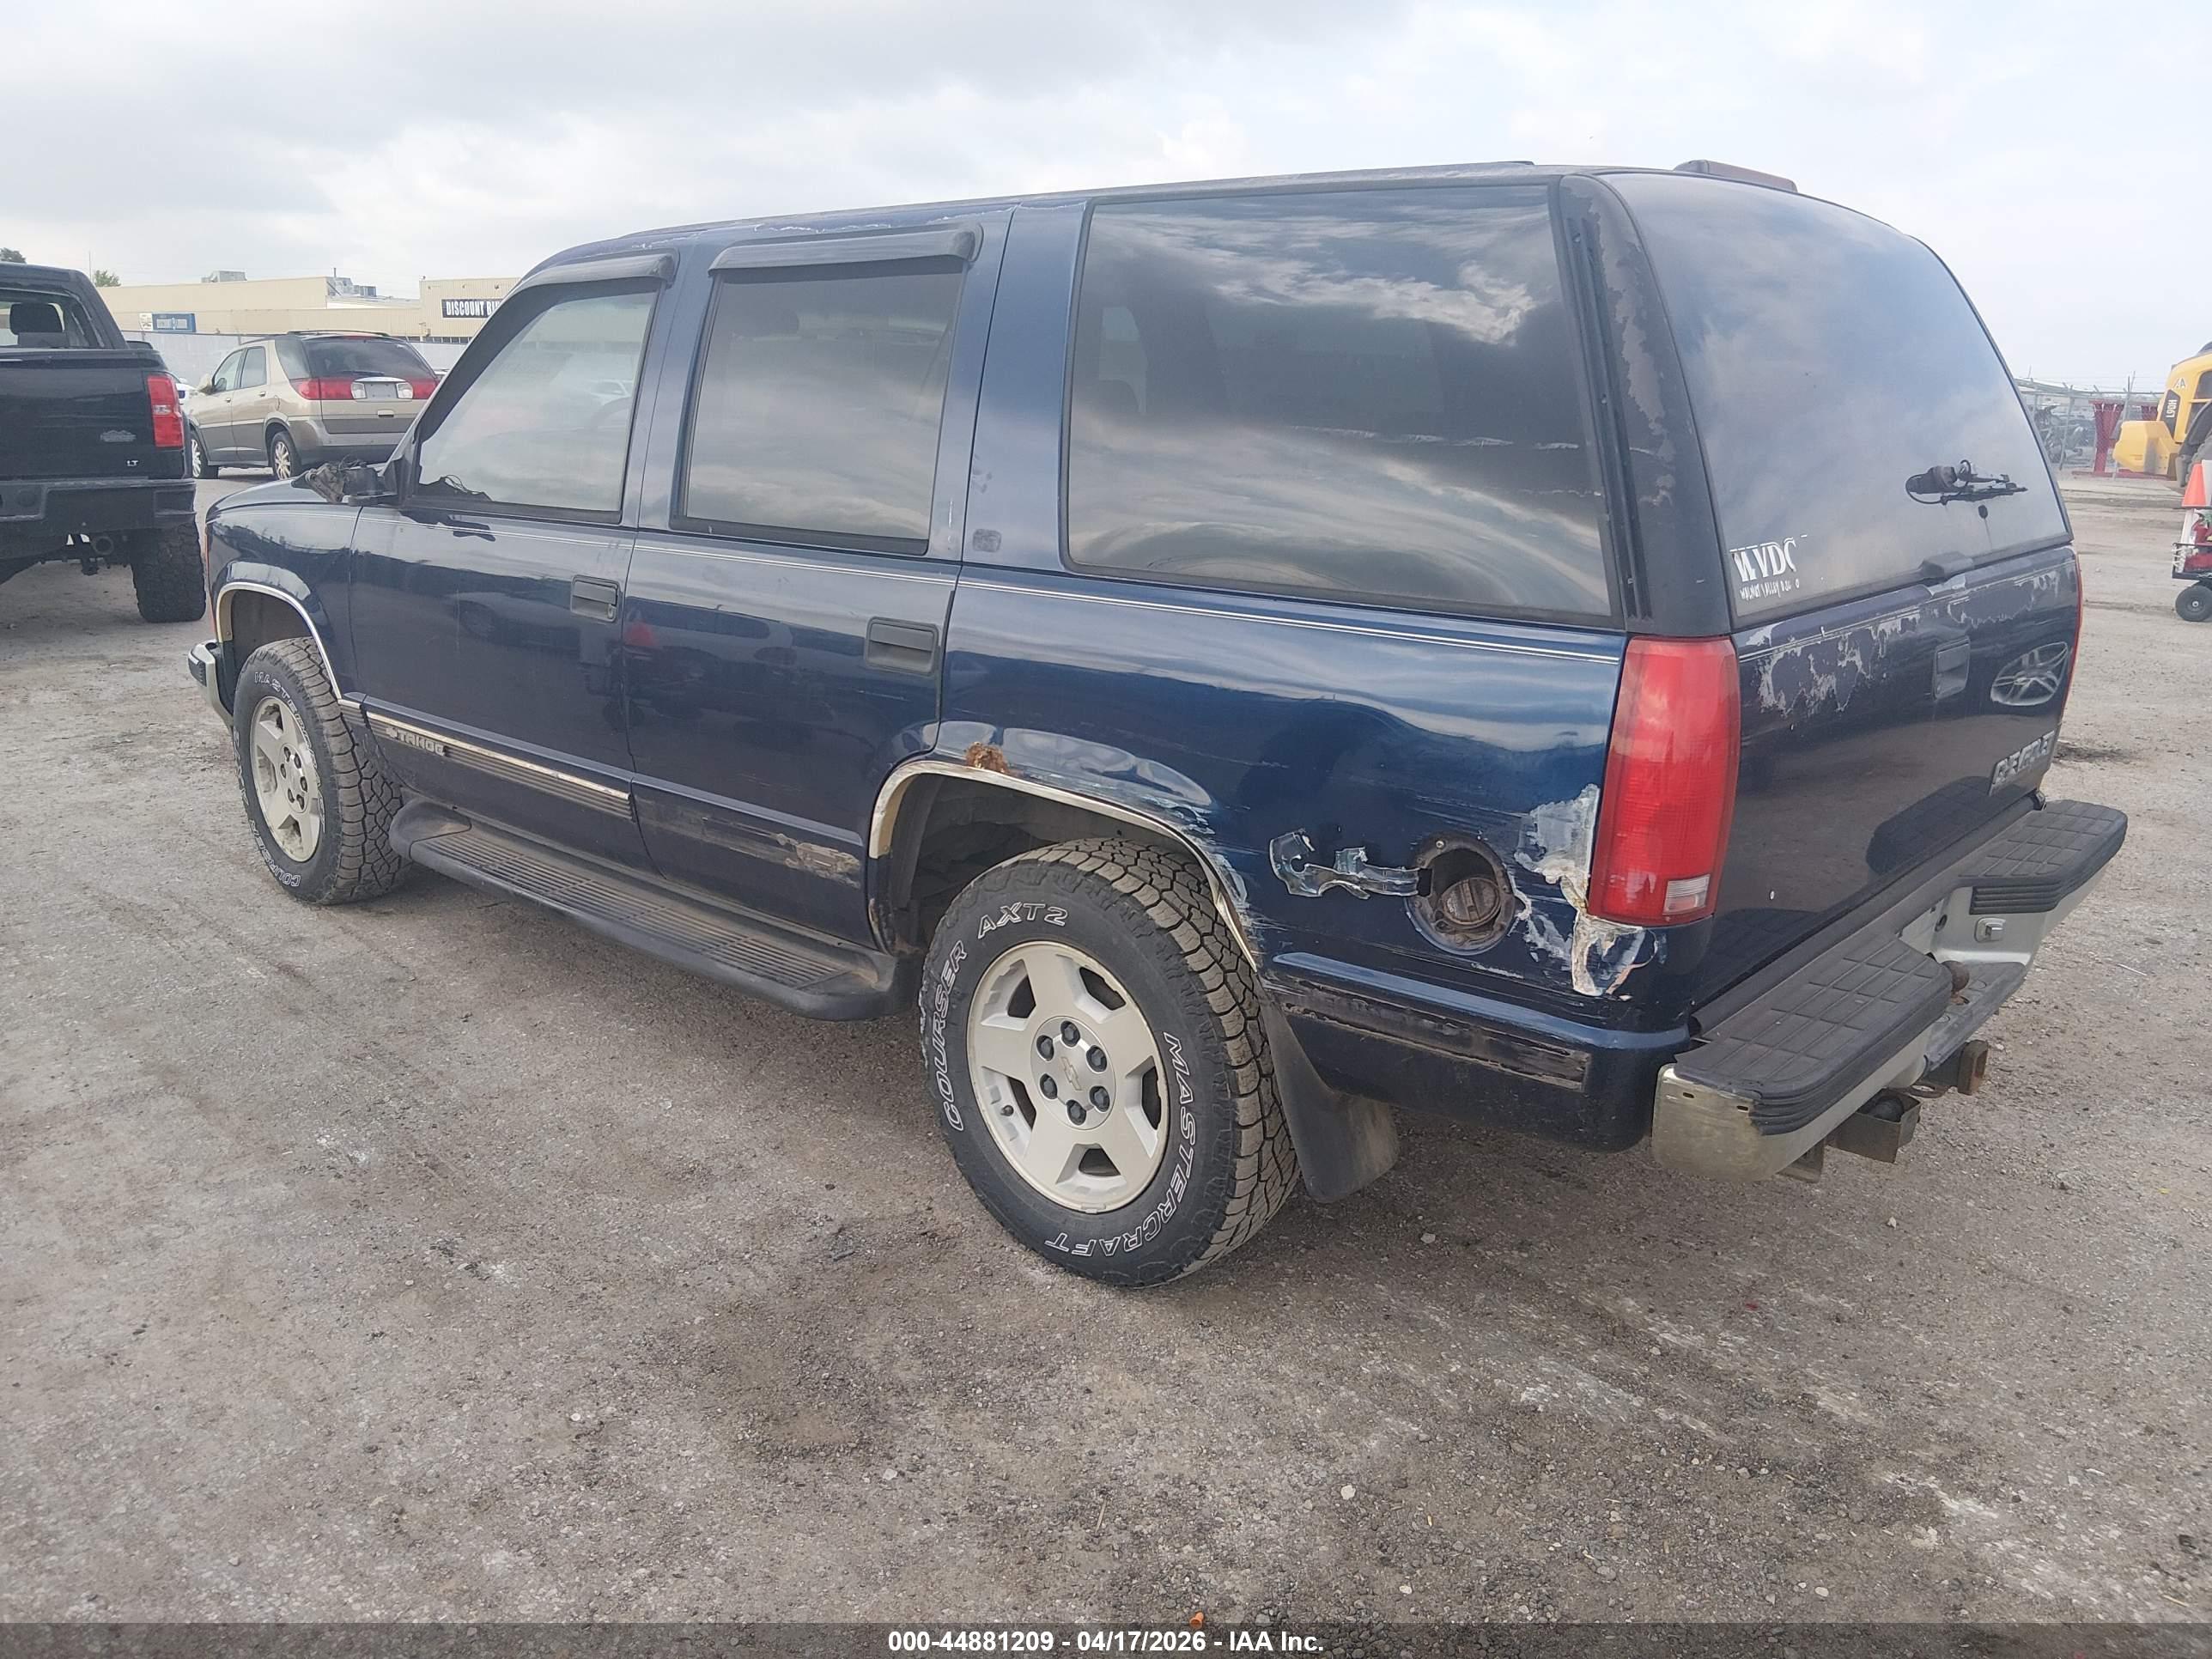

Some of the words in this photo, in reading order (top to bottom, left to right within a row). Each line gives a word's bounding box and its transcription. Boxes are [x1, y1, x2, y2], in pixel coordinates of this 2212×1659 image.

[446, 301, 484, 316] DISCOUNT
[933, 939, 968, 1132] COURSER
[976, 901, 1069, 939] AXT2
[1043, 1031, 1195, 1257] MASTERCRAFT
